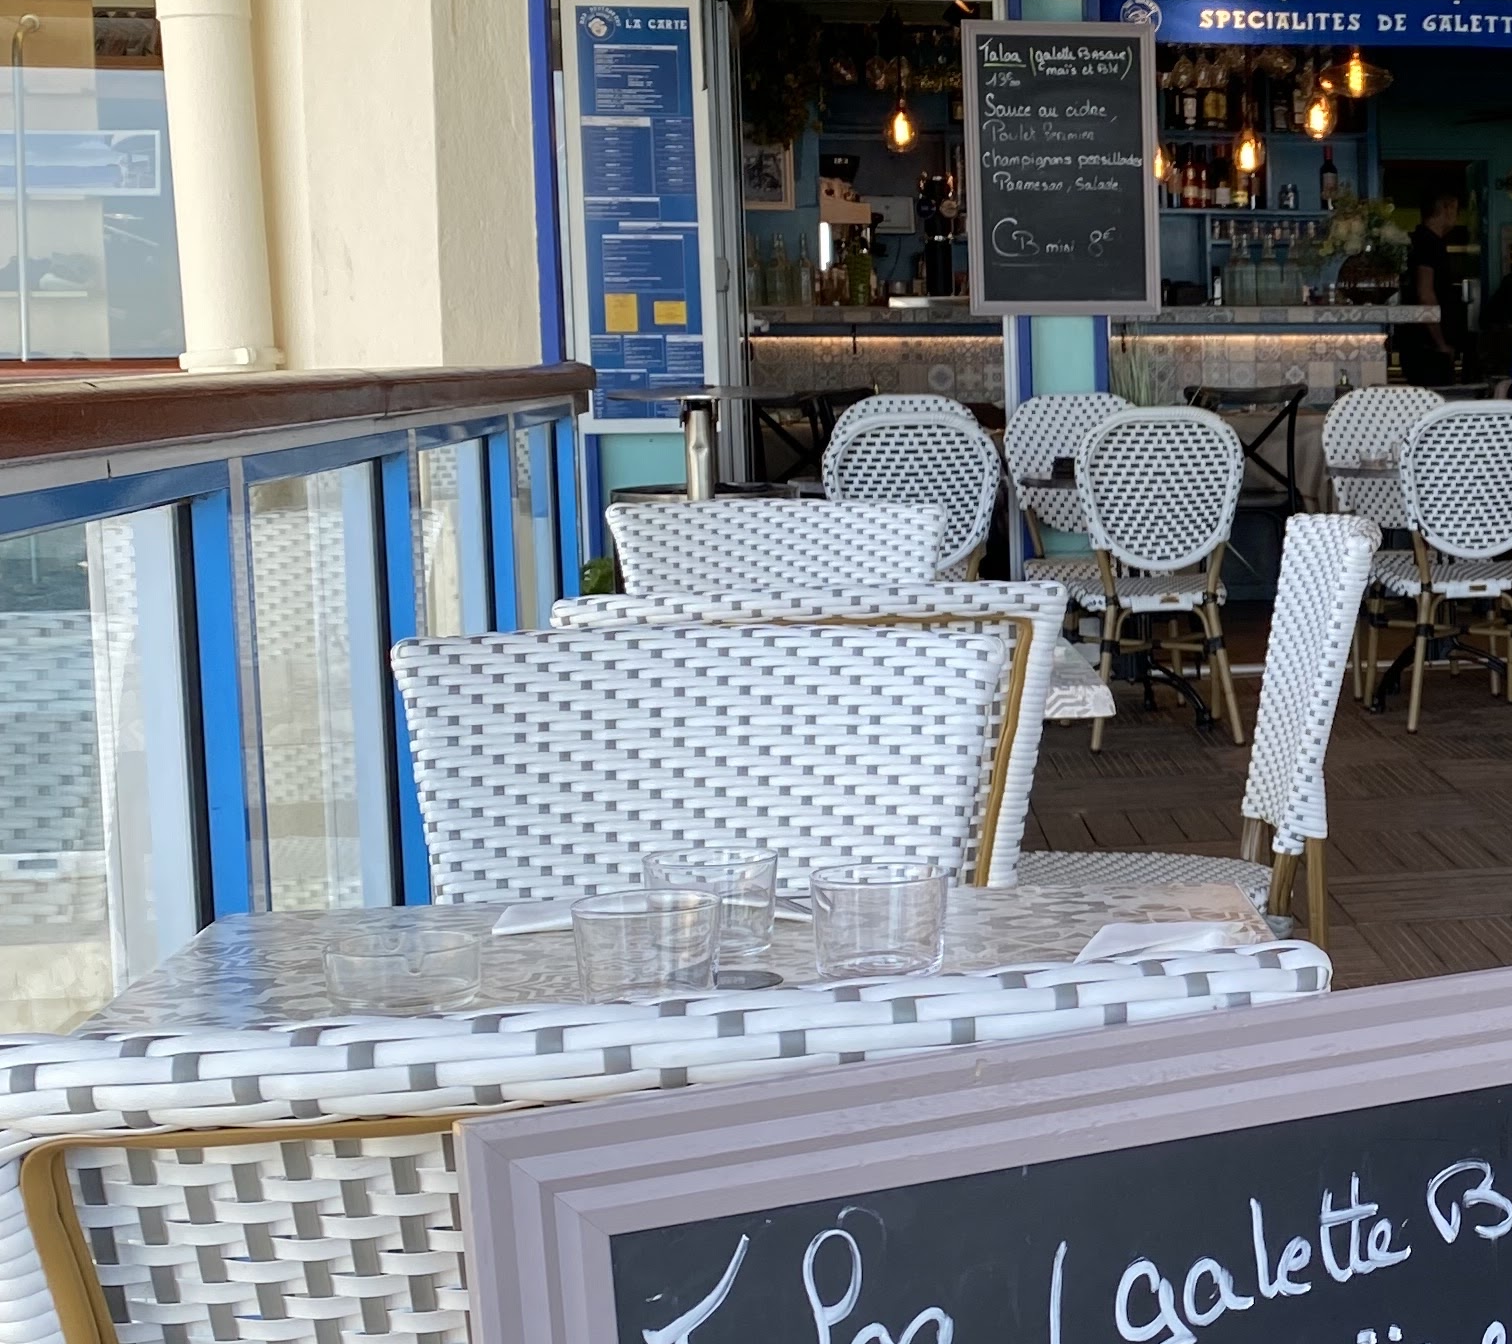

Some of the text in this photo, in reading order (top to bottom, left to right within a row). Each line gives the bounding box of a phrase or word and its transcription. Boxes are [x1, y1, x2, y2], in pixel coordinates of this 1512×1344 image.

[625, 19, 688, 30] LA CARTE
[1199, 9, 1362, 32] SPECIALITES
[1377, 13, 1407, 32] DE
[984, 92, 1032, 117] Sauce
[1038, 106, 1059, 118] au
[982, 118, 1036, 142] Poulet
